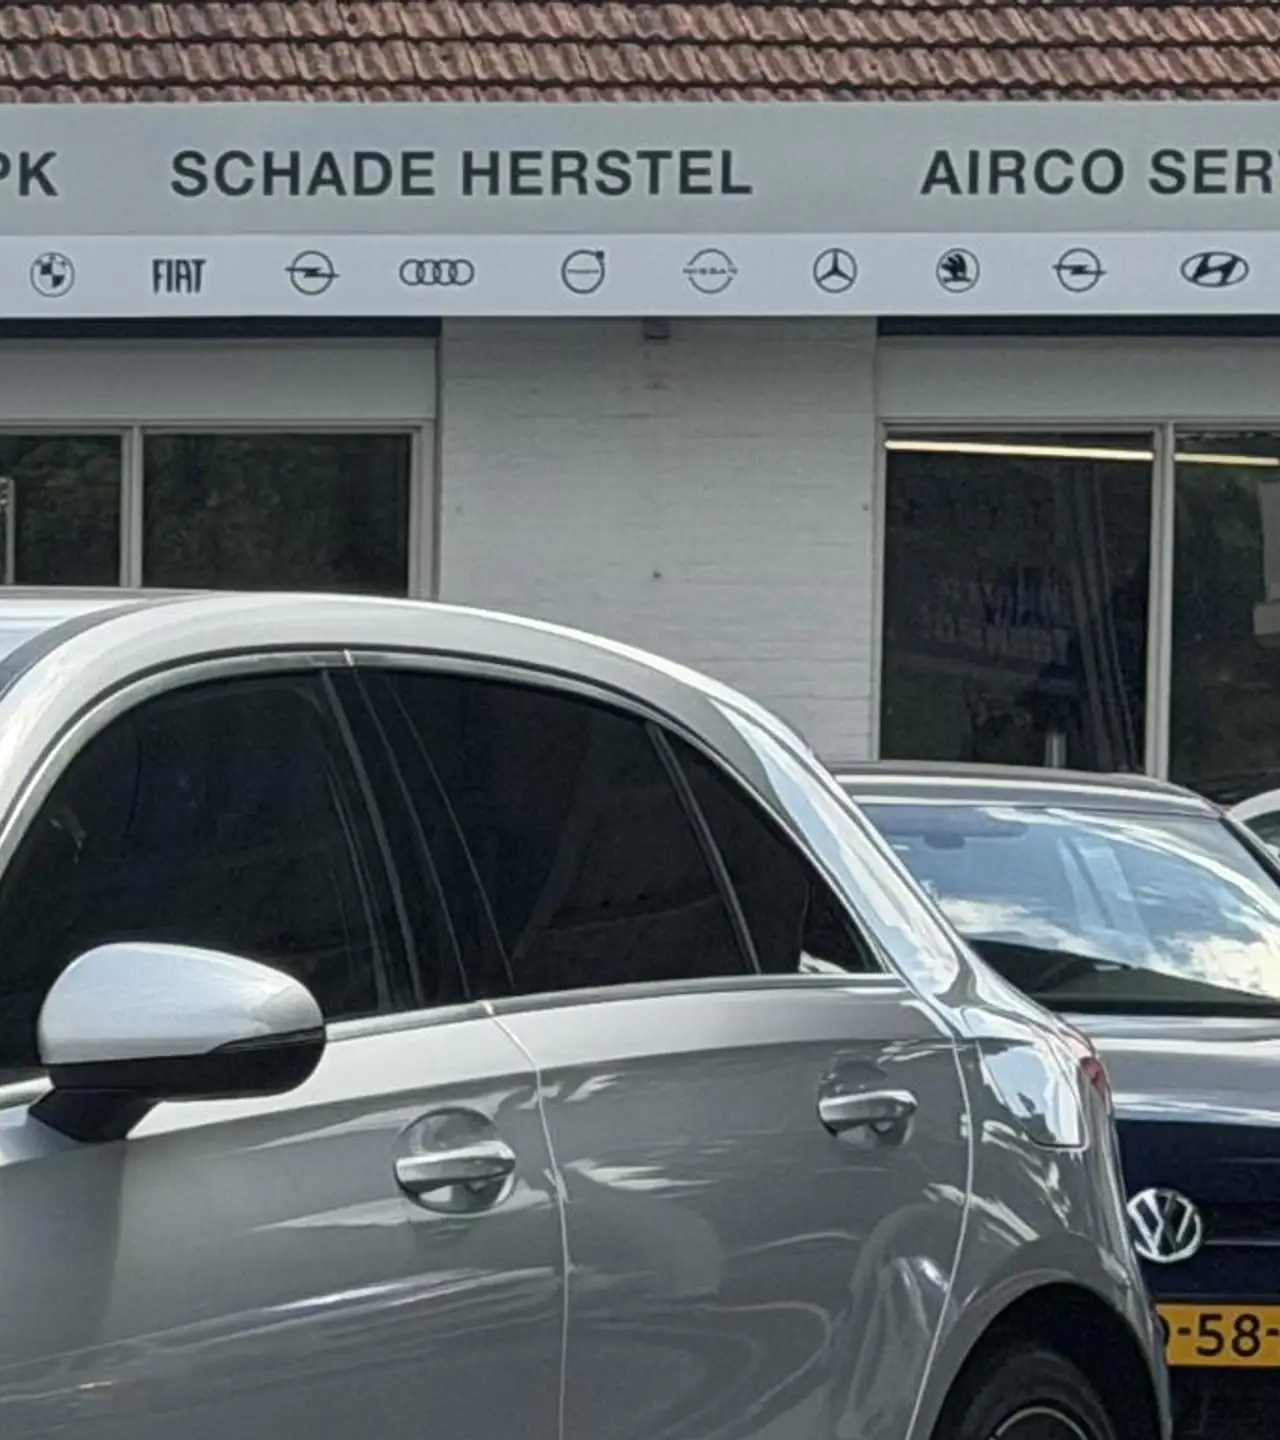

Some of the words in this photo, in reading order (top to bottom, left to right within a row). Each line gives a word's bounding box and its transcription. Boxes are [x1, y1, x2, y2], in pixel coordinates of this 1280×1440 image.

[171, 150, 435, 197] SCHADE
[462, 149, 752, 196] HERSTEL
[920, 148, 1124, 195] AIRCO
[1149, 148, 1280, 195] SER
[152, 259, 206, 294] FIAT
